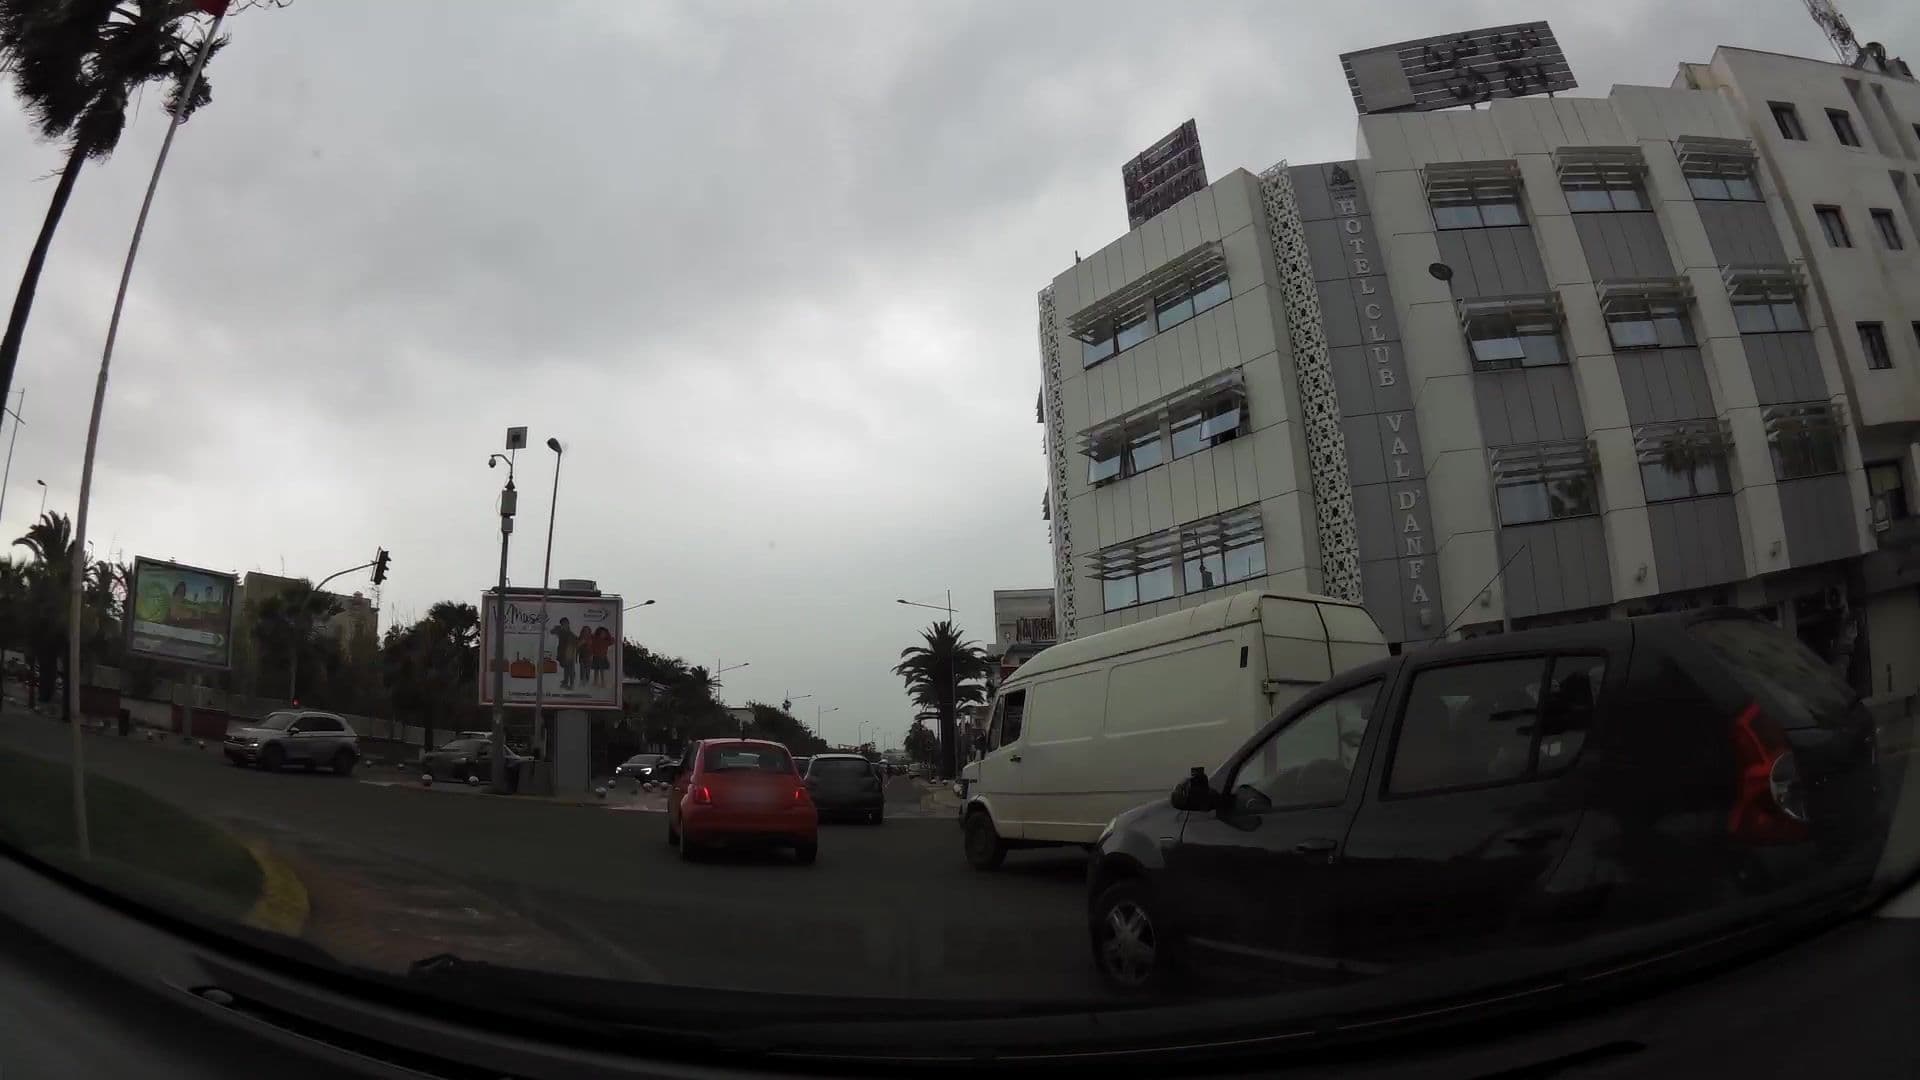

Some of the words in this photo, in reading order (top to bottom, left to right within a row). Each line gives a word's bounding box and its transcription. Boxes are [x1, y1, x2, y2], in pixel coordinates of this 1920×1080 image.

[1336, 200, 1375, 294] HOTEL
[1365, 303, 1395, 387] CLUB
[1386, 414, 1410, 477] VAL
[1399, 489, 1429, 603] D'ANFA
